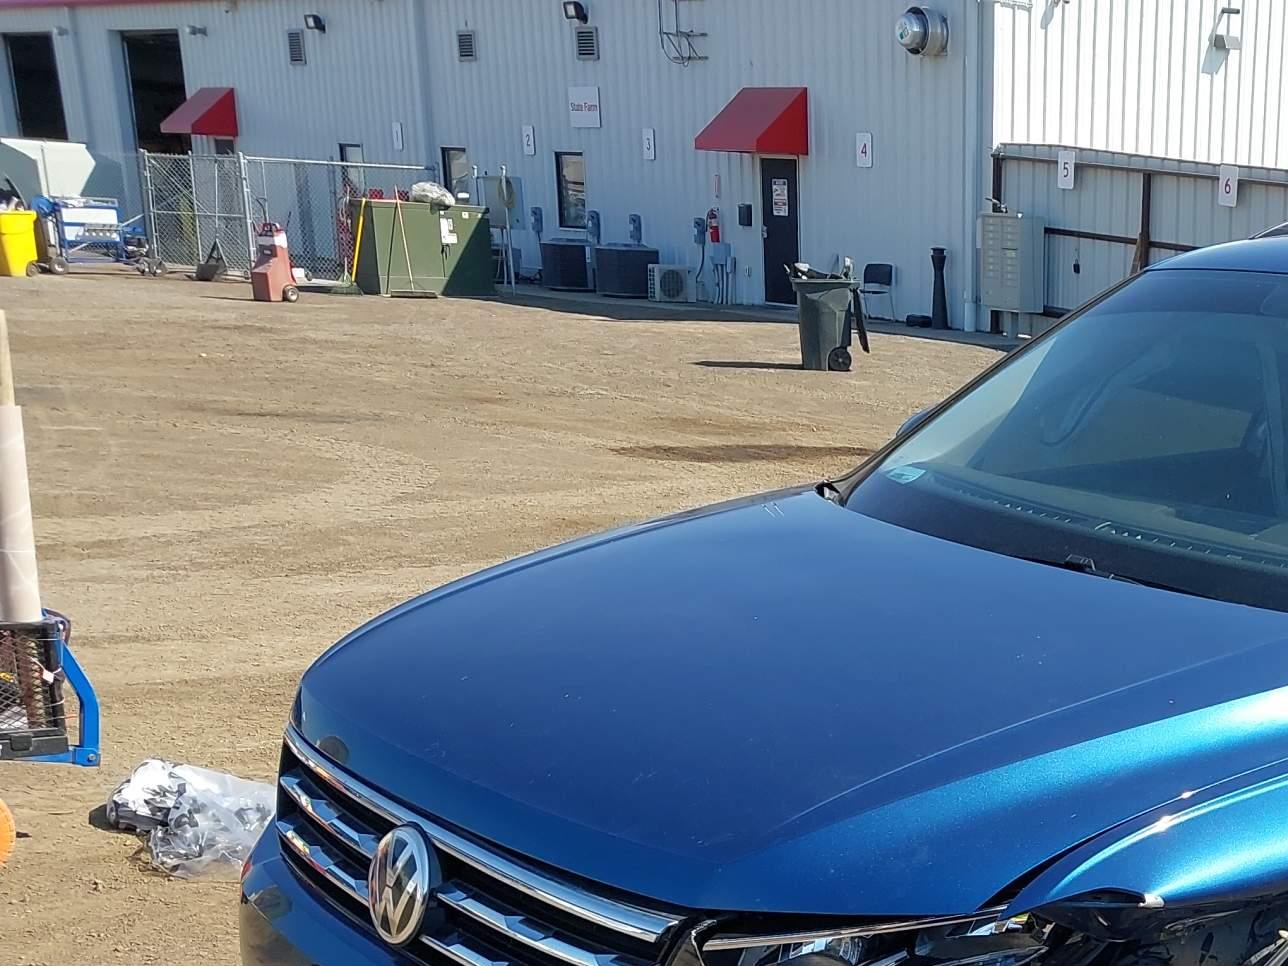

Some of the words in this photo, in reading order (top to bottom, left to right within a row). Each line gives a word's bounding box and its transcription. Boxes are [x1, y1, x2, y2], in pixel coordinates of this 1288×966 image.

[525, 134, 531, 147] 2
[646, 136, 651, 151] 3
[860, 142, 868, 158] 4
[1063, 161, 1070, 178] 5
[1224, 177, 1231, 194] 6
